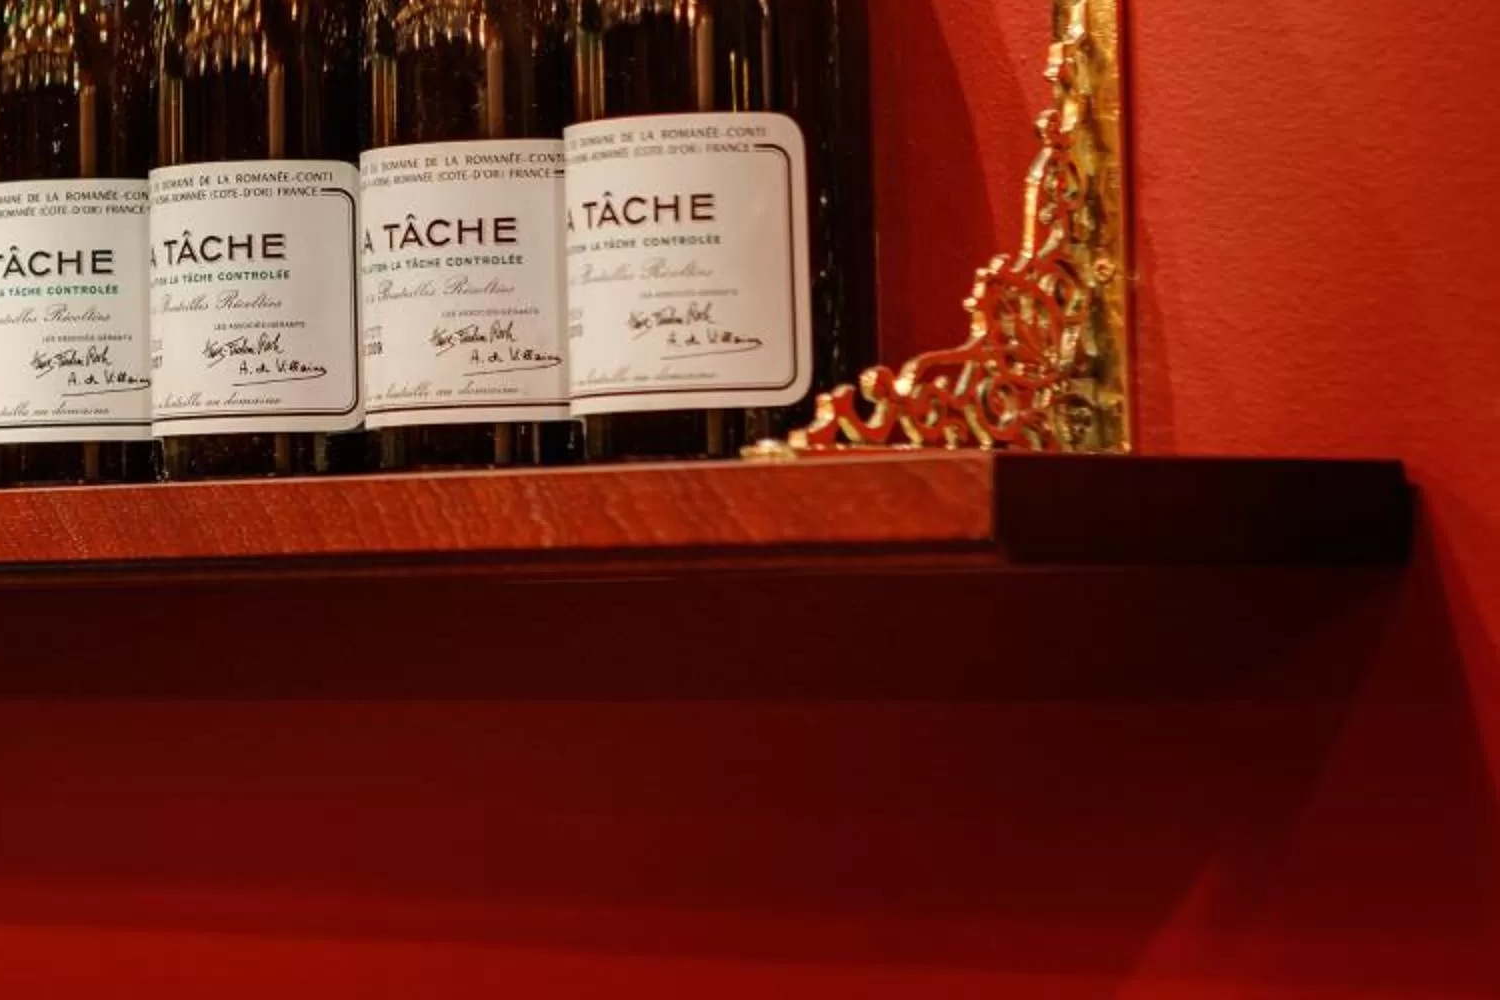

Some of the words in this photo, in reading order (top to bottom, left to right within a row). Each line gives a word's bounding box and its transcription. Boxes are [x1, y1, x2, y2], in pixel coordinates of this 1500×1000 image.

[445, 155, 459, 166] LA
[509, 167, 550, 179] FRANCE
[46, 191, 59, 202] LA
[65, 189, 149, 201] ROMANÉE-CON
[277, 186, 318, 198] FRANCE
[105, 204, 145, 215] FRANCE
[582, 191, 715, 229] TÂCHE
[383, 213, 517, 250] TÂCHE
[164, 229, 286, 265] TÂCHE
[405, 257, 441, 269] TÂCHE
[182, 271, 213, 284] TÂCHE
[8, 285, 41, 297] TÂCHE
